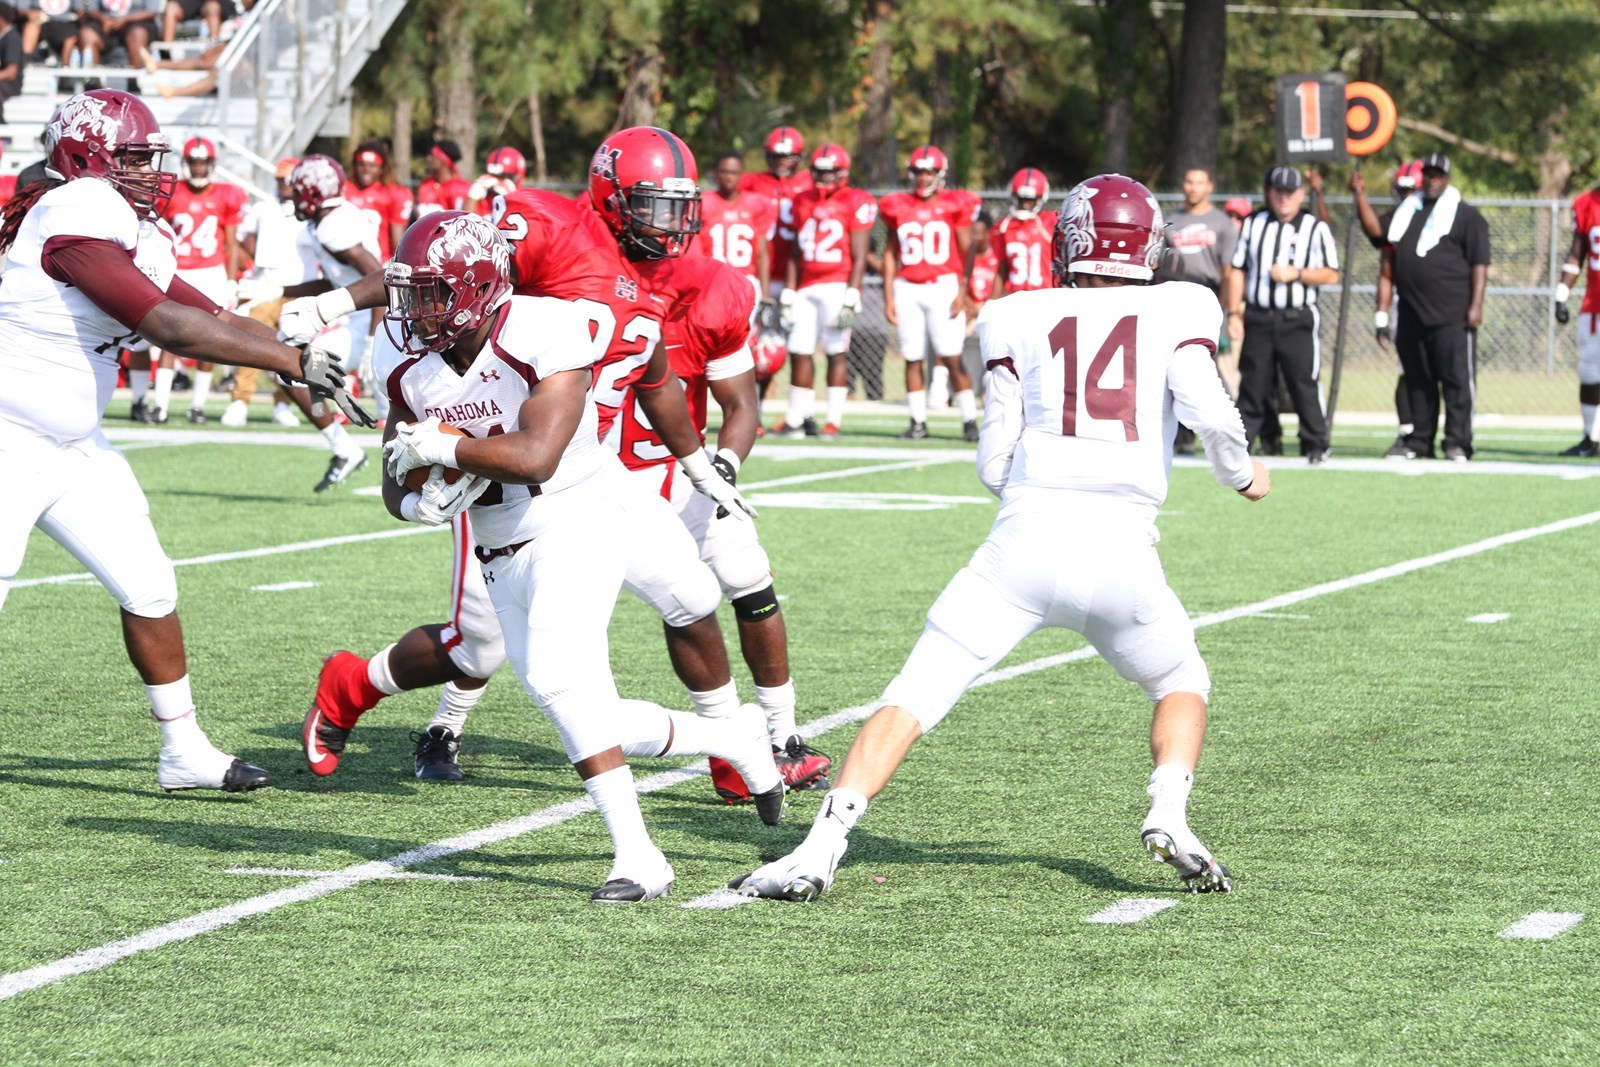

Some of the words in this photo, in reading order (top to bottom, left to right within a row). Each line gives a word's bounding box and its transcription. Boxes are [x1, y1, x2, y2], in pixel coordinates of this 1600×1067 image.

[1294, 81, 1321, 140] 1
[173, 213, 218, 258] 24
[709, 223, 754, 268] 16
[798, 217, 844, 263] 42
[897, 220, 950, 266] 60
[1006, 241, 1044, 287] 31
[1094, 263, 1141, 277] Ridde
[1047, 315, 1139, 442] 14
